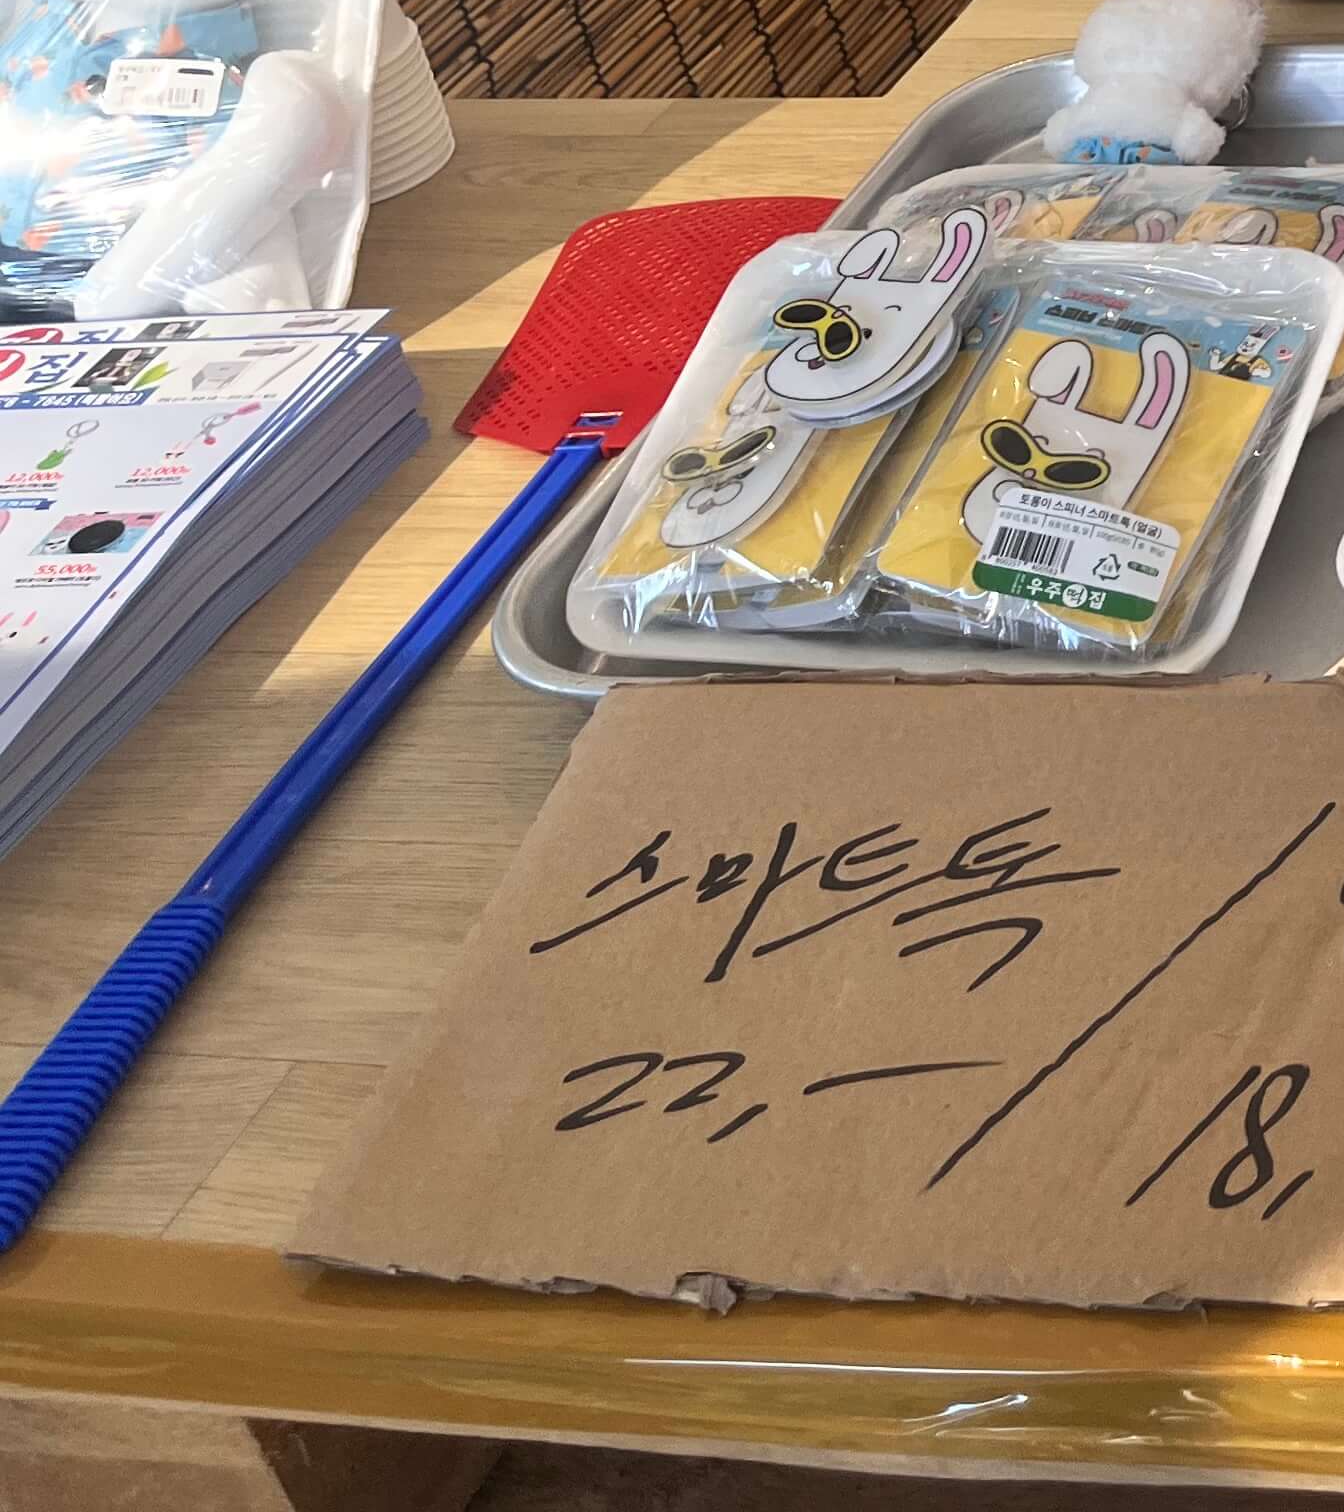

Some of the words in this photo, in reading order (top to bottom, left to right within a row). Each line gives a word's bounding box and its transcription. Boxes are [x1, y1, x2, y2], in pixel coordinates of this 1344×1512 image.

[1053, 499, 1086, 516] 스피너
[1087, 508, 1131, 527] 스마트톡
[1132, 520, 1162, 539] (얼굴)
[1026, 577, 1107, 610] 우주떡집
[531, 806, 1122, 992] 스마트톡
